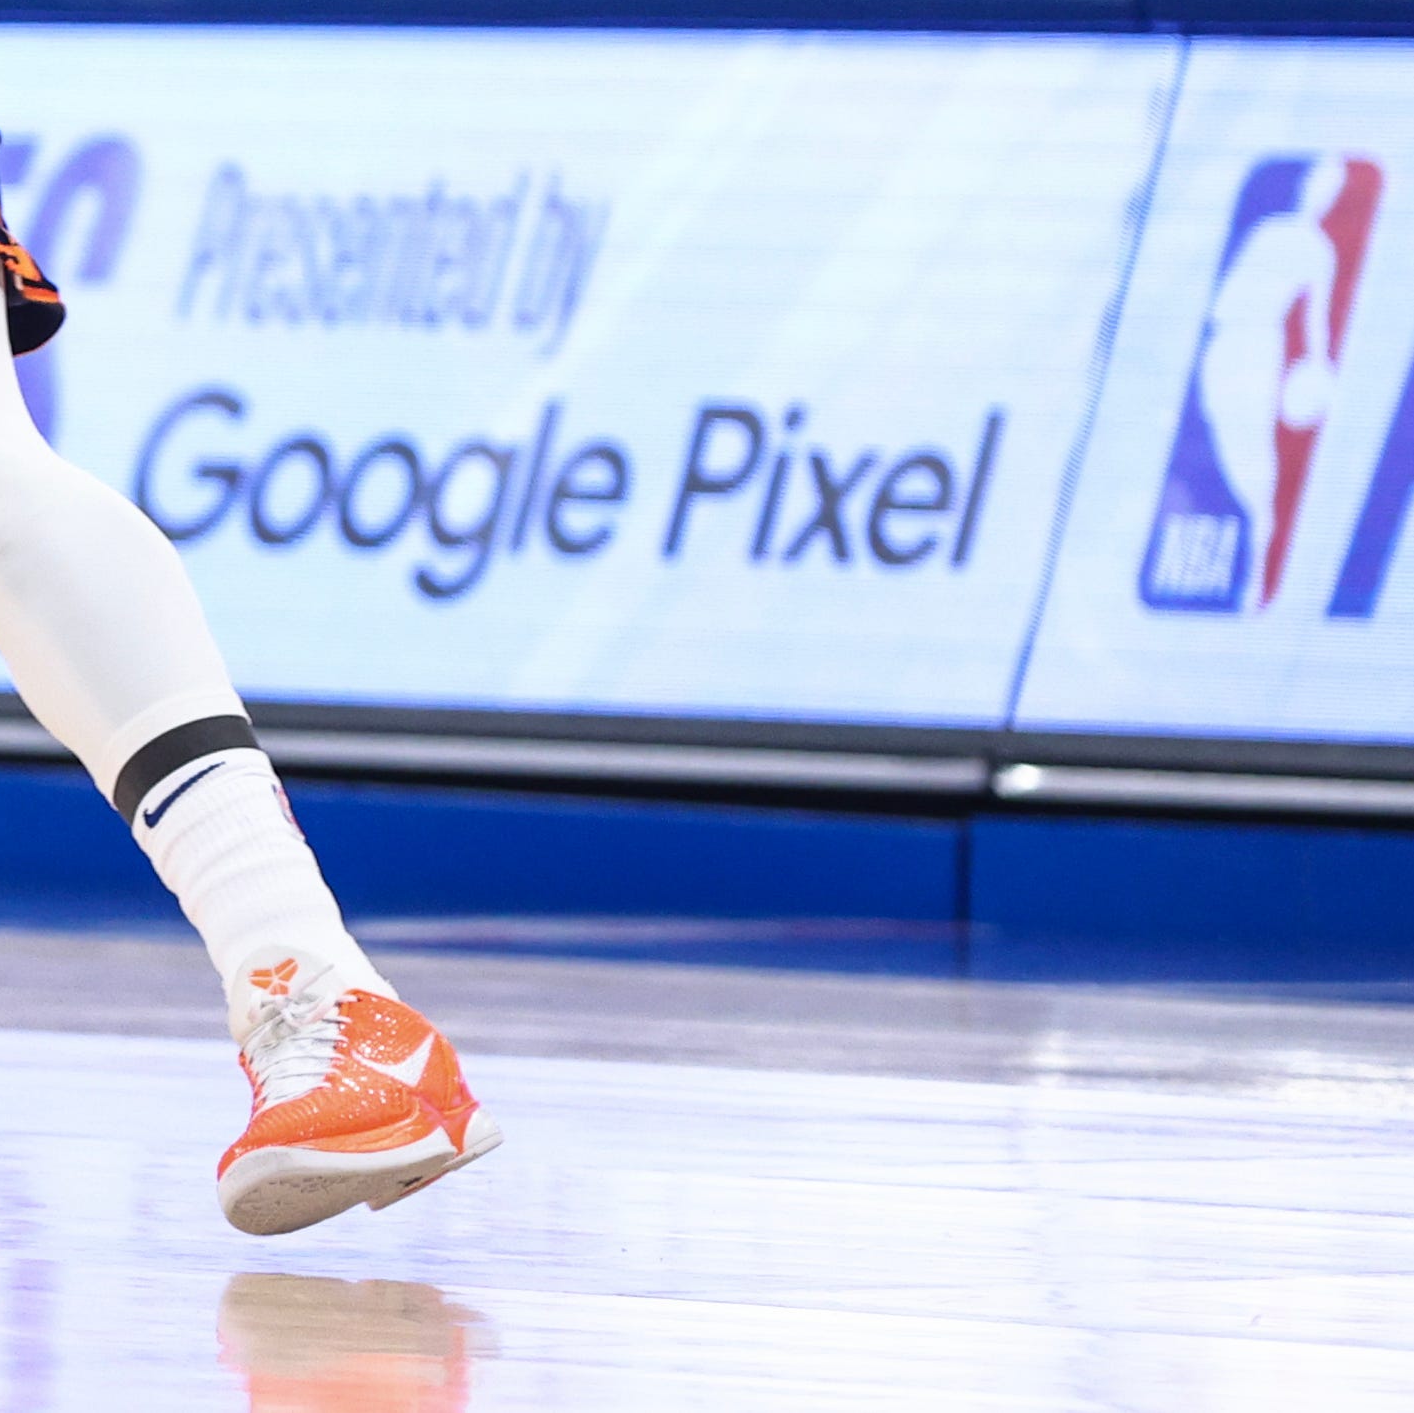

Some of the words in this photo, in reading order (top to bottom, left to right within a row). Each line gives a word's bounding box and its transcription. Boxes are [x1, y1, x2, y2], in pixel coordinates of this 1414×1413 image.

[511, 168, 613, 362] by
[135, 383, 633, 606] Google
[659, 398, 1011, 574] Pixel
